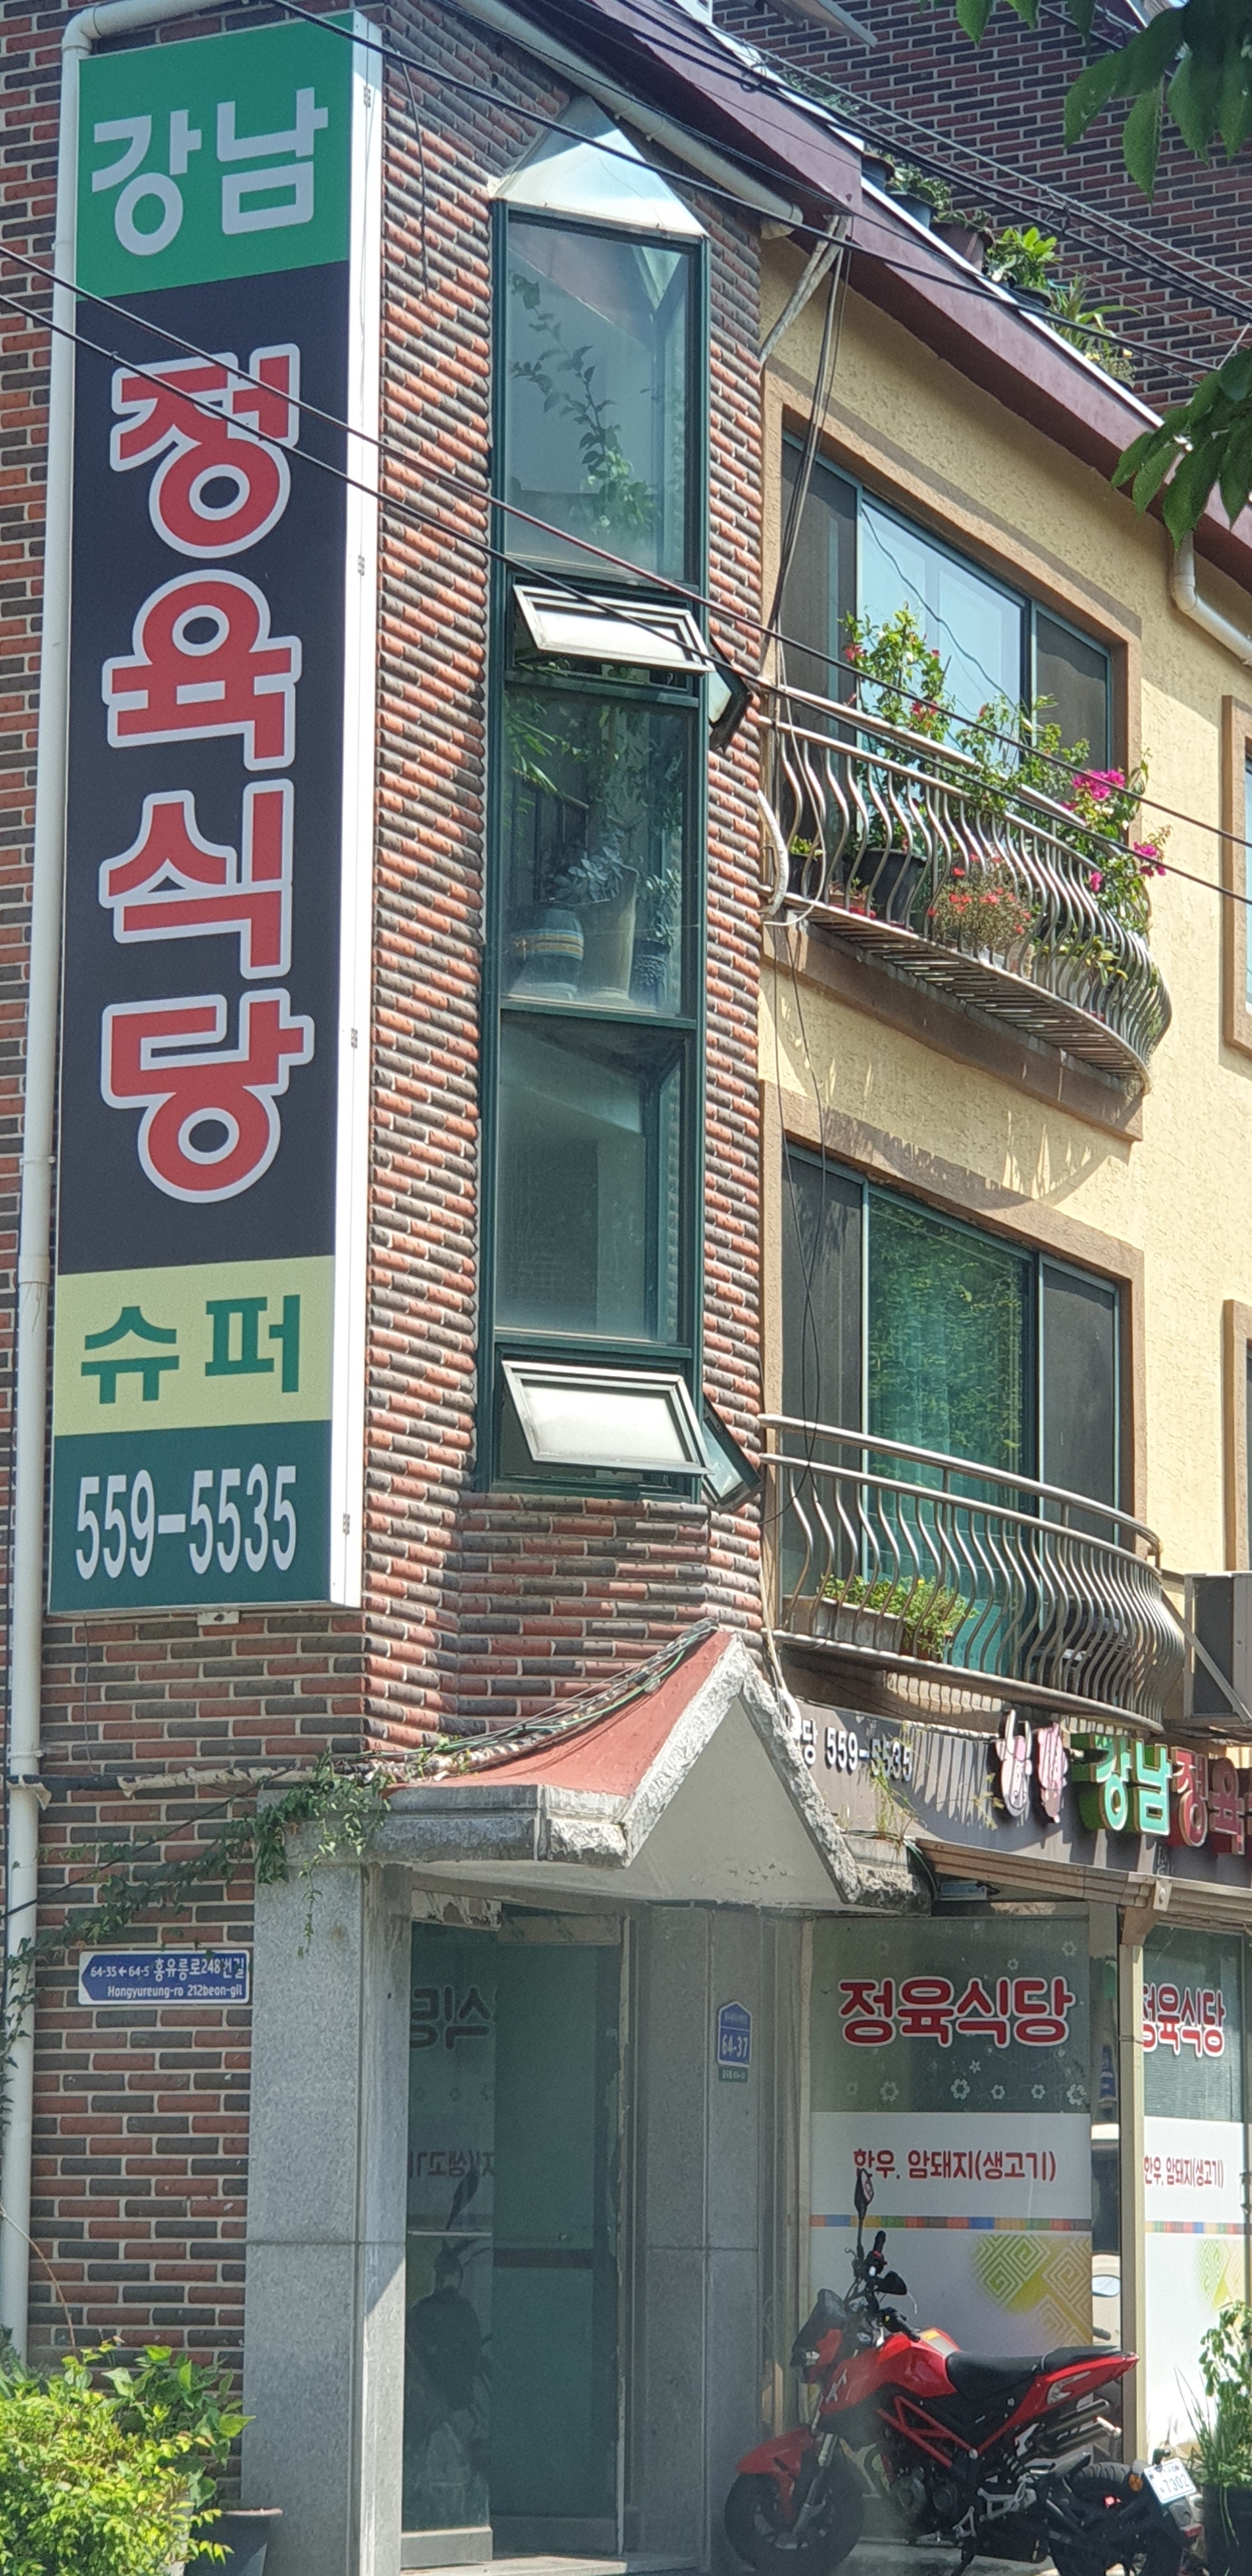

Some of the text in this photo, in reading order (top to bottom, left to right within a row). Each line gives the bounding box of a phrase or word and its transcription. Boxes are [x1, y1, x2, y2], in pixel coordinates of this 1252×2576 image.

[91, 86, 328, 256] 강남
[99, 342, 314, 1203] 정육식당
[80, 1294, 301, 1404] 슈퍼
[75, 1462, 298, 1580] 559-5535
[827, 1727, 913, 1782] 559-5535
[89, 1965, 118, 1979] 64-35
[128, 1965, 150, 1978] 64-5
[107, 1984, 243, 1999] Hongyureung-ro 212beon-gil
[837, 1975, 1076, 2048] 정육식당
[722, 2034, 748, 2058] 64-37
[907, 2149, 1057, 2182] 암돼지(생고기)
[1166, 2157, 1224, 2189] 암돼지(생고기)
[1163, 2474, 1189, 2493] 7302
